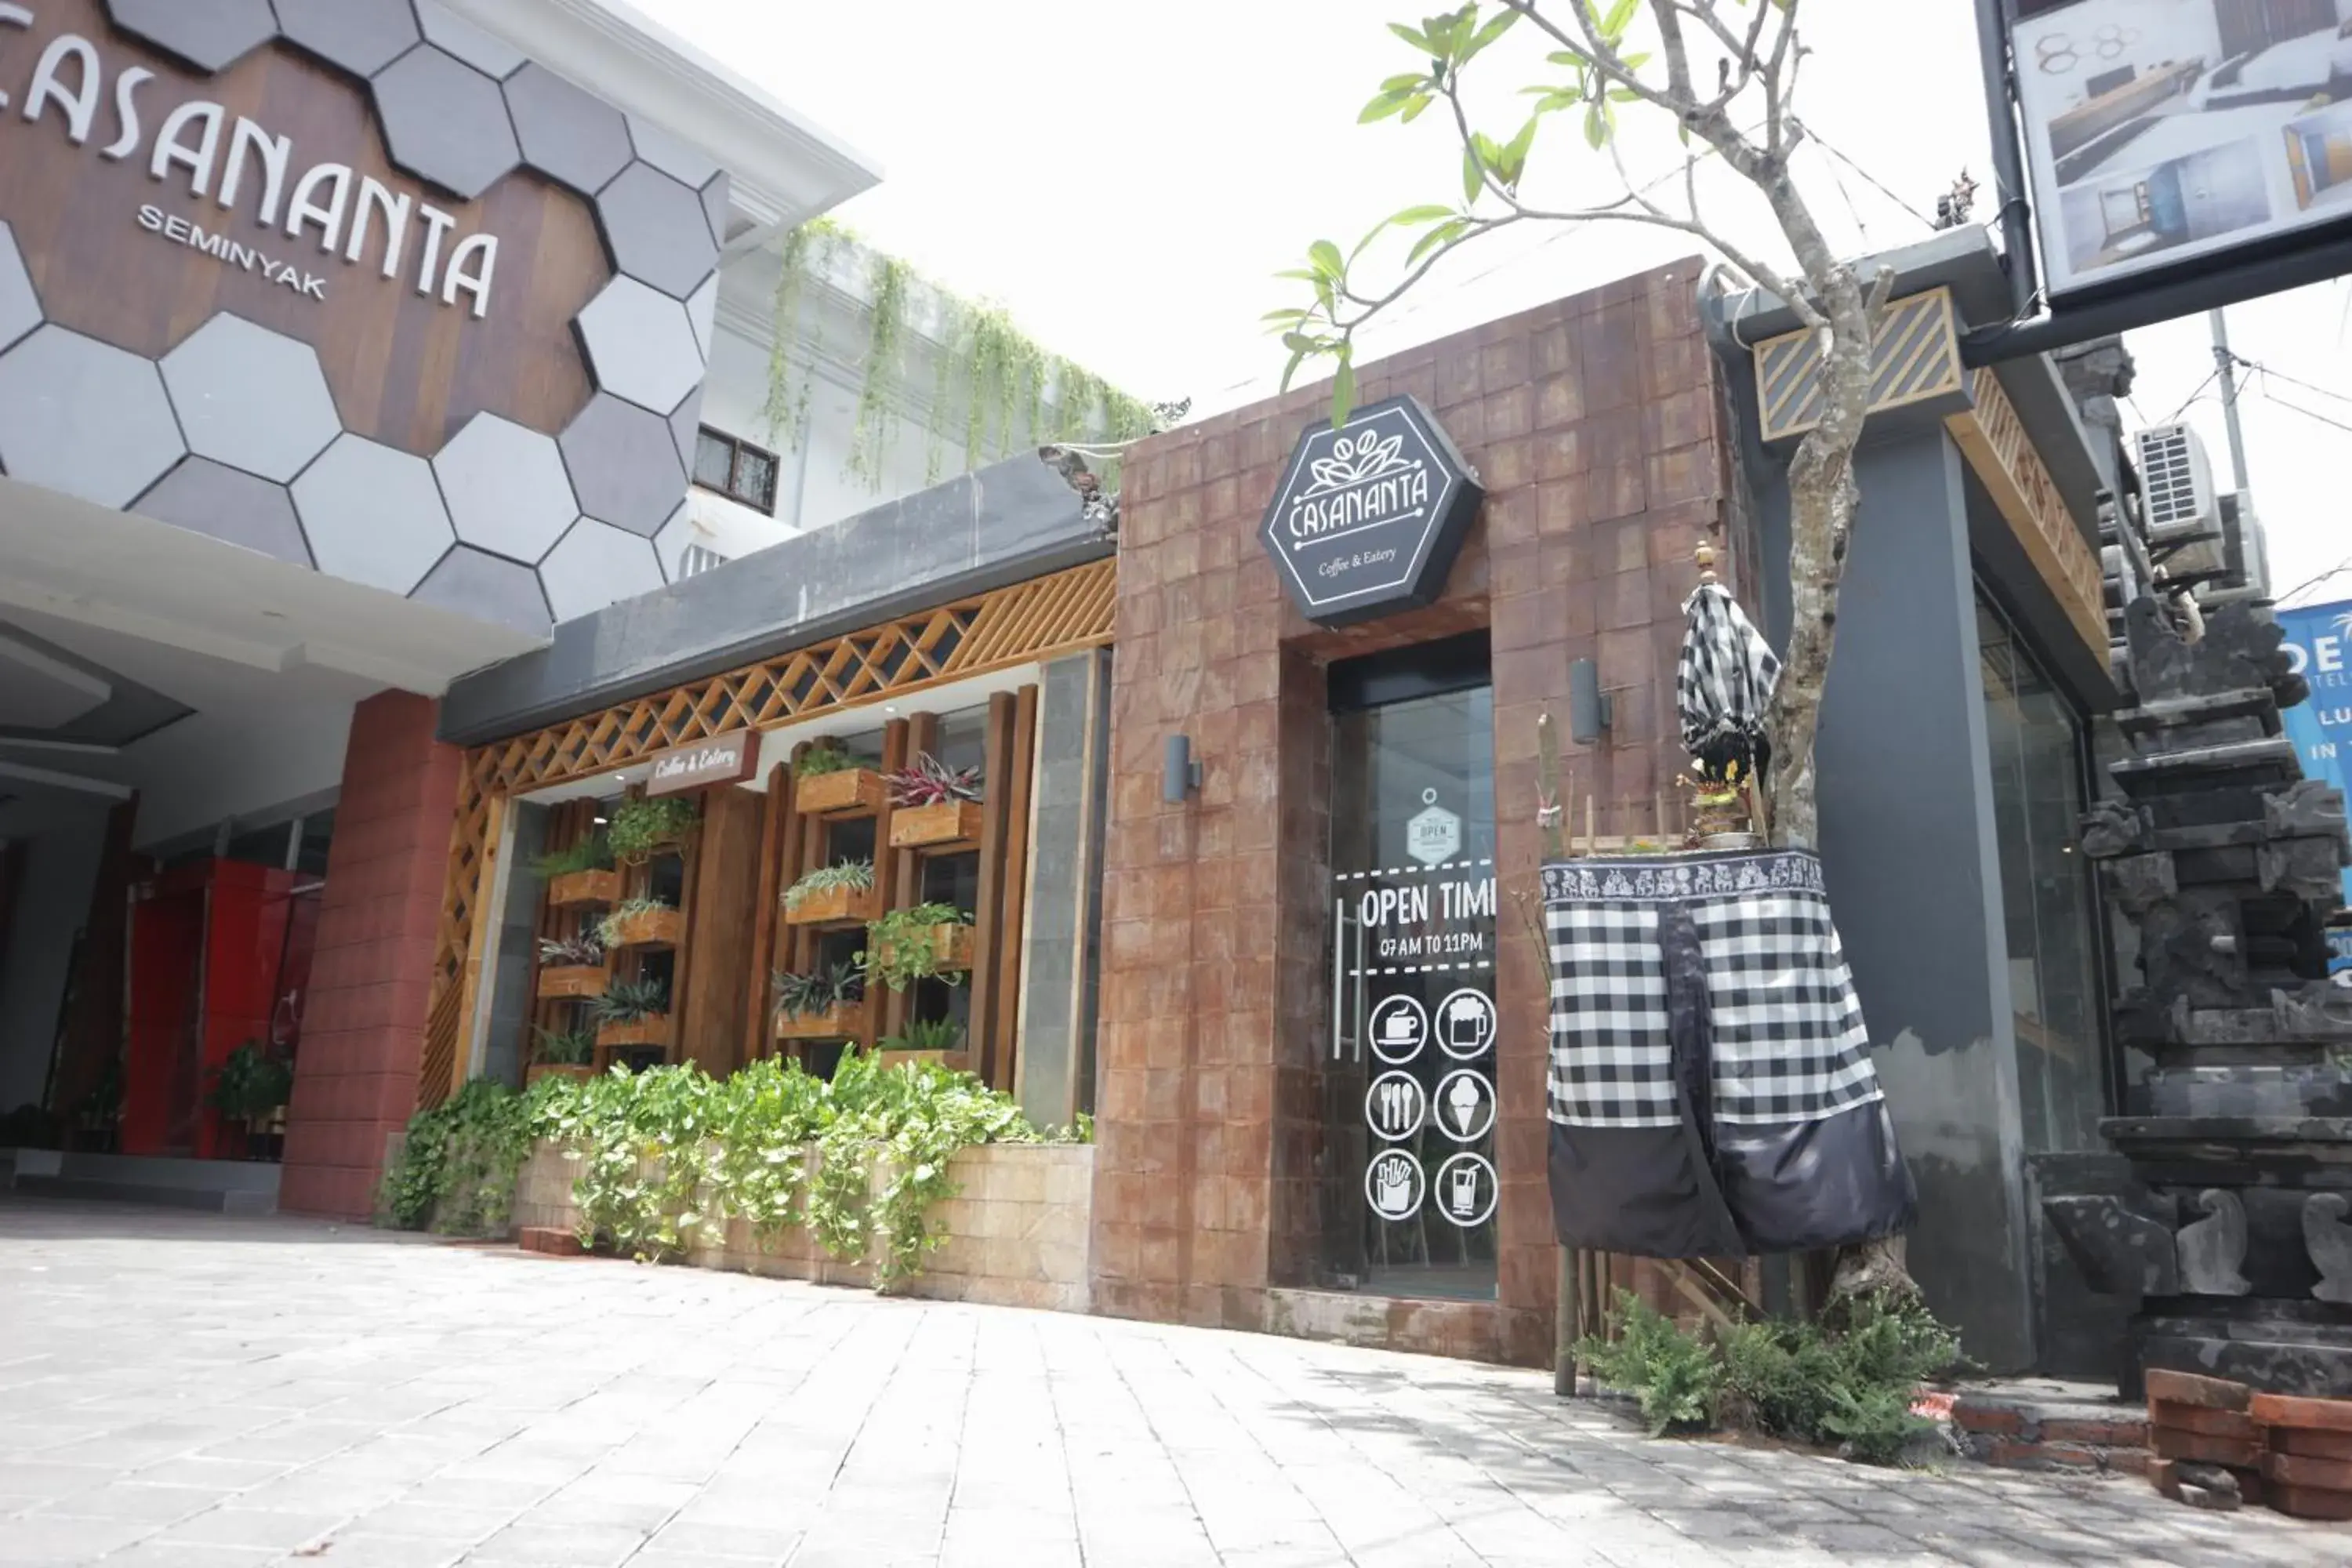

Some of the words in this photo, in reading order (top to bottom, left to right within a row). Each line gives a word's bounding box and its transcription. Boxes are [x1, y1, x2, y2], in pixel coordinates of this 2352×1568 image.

[137, 204, 327, 302] SEMINYAK
[1290, 468, 1428, 537] CASANANTA
[1318, 557, 1349, 578] Coffee
[1352, 554, 1362, 568] &
[1363, 547, 1396, 564] Eatery
[2311, 742, 2336, 760] IN
[1420, 825, 1447, 837] OPEN
[1362, 884, 1428, 927] OPEN
[1425, 934, 1441, 954] TO
